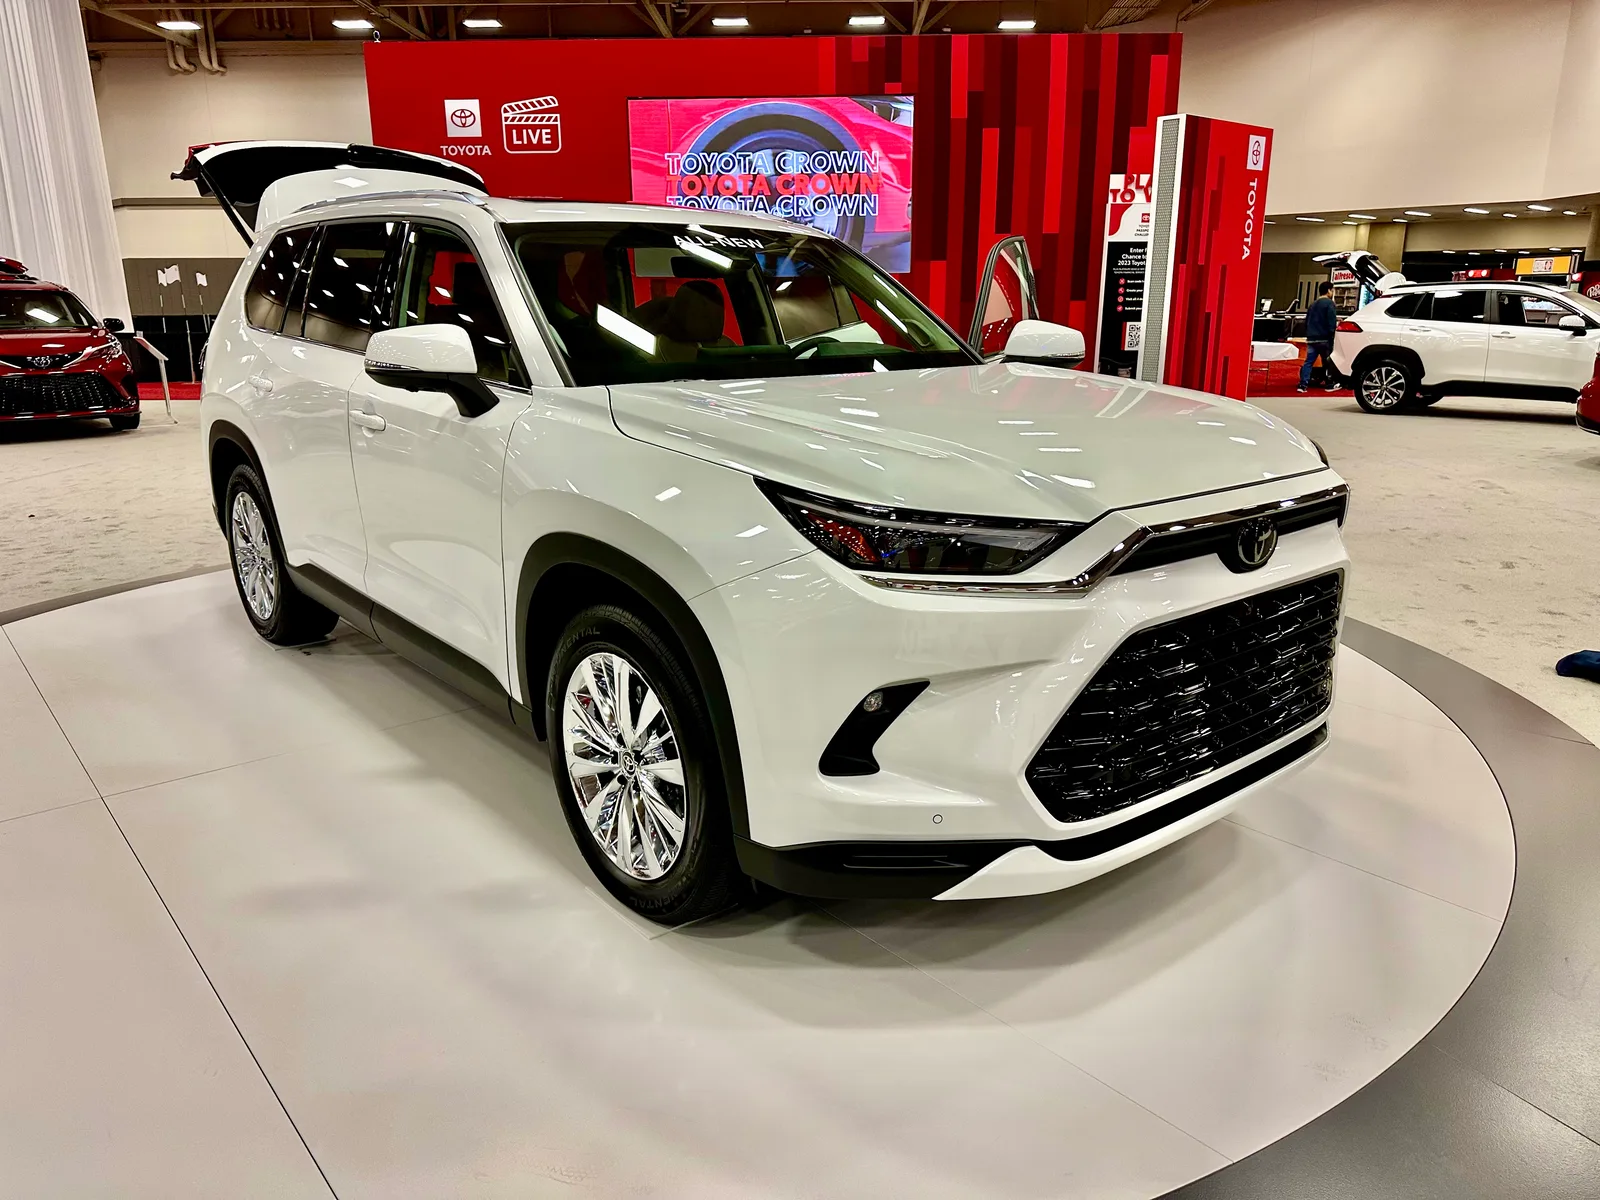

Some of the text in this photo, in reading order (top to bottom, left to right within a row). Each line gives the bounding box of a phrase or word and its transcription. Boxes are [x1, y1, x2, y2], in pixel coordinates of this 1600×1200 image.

[512, 129, 552, 145] LIVE
[440, 145, 492, 156] TOYOTA
[665, 150, 879, 175] TOYOTA CROWN
[666, 173, 878, 197] TOYOTA CROWN
[775, 194, 879, 217] CROWN
[1110, 189, 1135, 203] TO
[1242, 178, 1258, 260] TOYOTA
[673, 235, 765, 250] ALL-NEW
